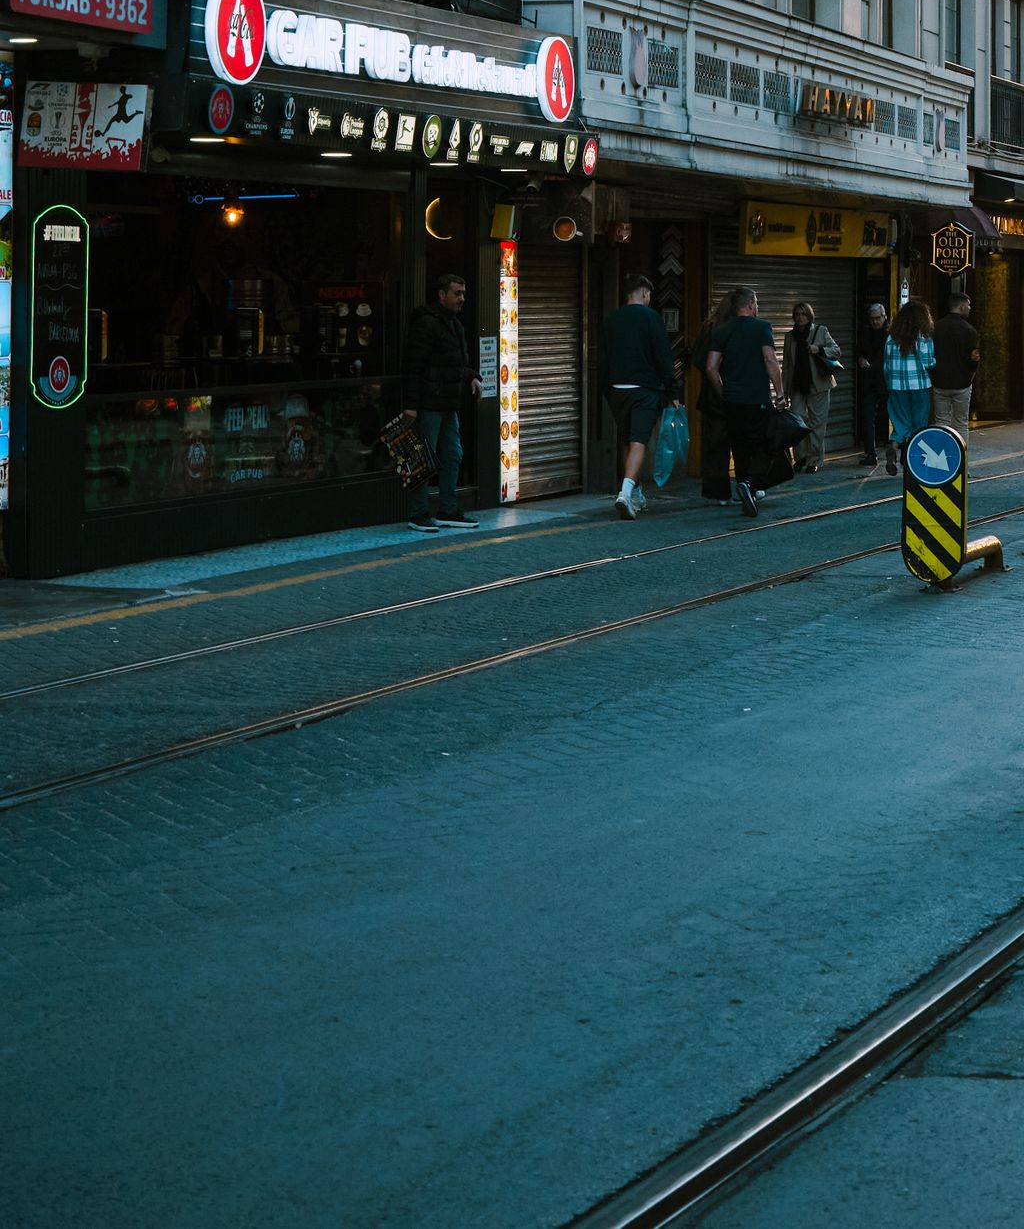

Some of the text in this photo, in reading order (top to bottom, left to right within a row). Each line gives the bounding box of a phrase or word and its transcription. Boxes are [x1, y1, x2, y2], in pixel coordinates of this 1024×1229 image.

[267, 9, 344, 73] GAR
[344, 23, 411, 83] PUB
[938, 237, 964, 247] OLD
[936, 248, 967, 258] PORT
